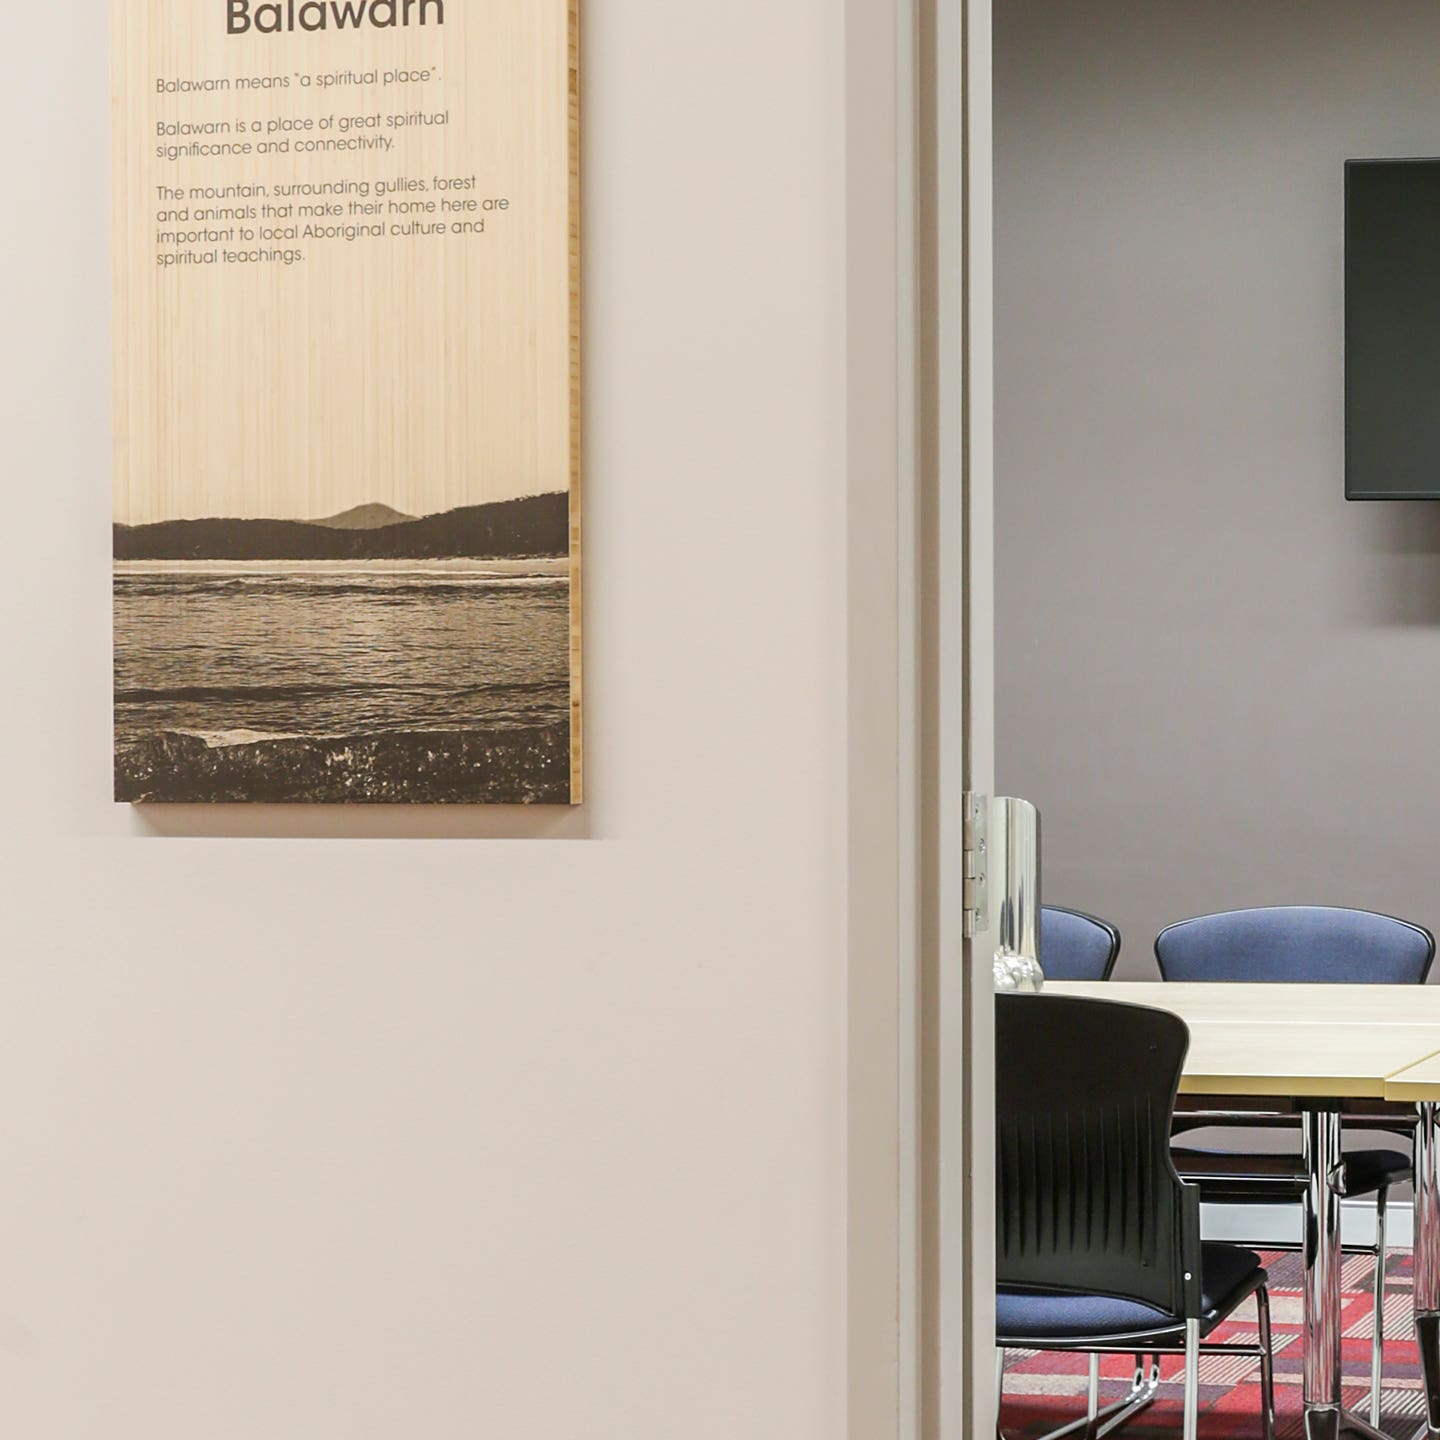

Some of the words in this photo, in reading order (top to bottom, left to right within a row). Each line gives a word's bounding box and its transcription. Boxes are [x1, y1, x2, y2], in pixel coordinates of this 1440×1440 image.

[156, 78, 230, 93] Balawarn
[236, 76, 290, 89] means
[316, 68, 378, 88] spiritual
[156, 121, 230, 136] Balawarn
[236, 119, 246, 132] is
[251, 120, 262, 132] a
[267, 117, 313, 134] place
[319, 114, 334, 130] of
[338, 113, 381, 132] great
[387, 110, 449, 130] spiritual
[156, 142, 252, 160] significance
[257, 139, 289, 153] and
[295, 134, 395, 152] connectivity.
[156, 186, 184, 200] The
[190, 184, 269, 199] mountain,
[273, 179, 369, 197] surrounding
[374, 177, 429, 196] gullies,
[433, 175, 476, 190] forest
[156, 208, 188, 222] and
[194, 206, 256, 220] animals
[262, 204, 293, 218] that
[298, 202, 343, 217] make
[348, 201, 382, 215] their
[389, 200, 435, 213] home
[441, 198, 477, 211] here
[482, 198, 509, 210] are
[156, 229, 234, 245] important
[240, 227, 254, 240] to
[259, 225, 298, 239] local
[303, 222, 385, 241] Aboriginal
[391, 220, 446, 236] culture
[451, 219, 484, 233] and
[156, 250, 217, 268] spiritual
[223, 247, 305, 265] teachings.
